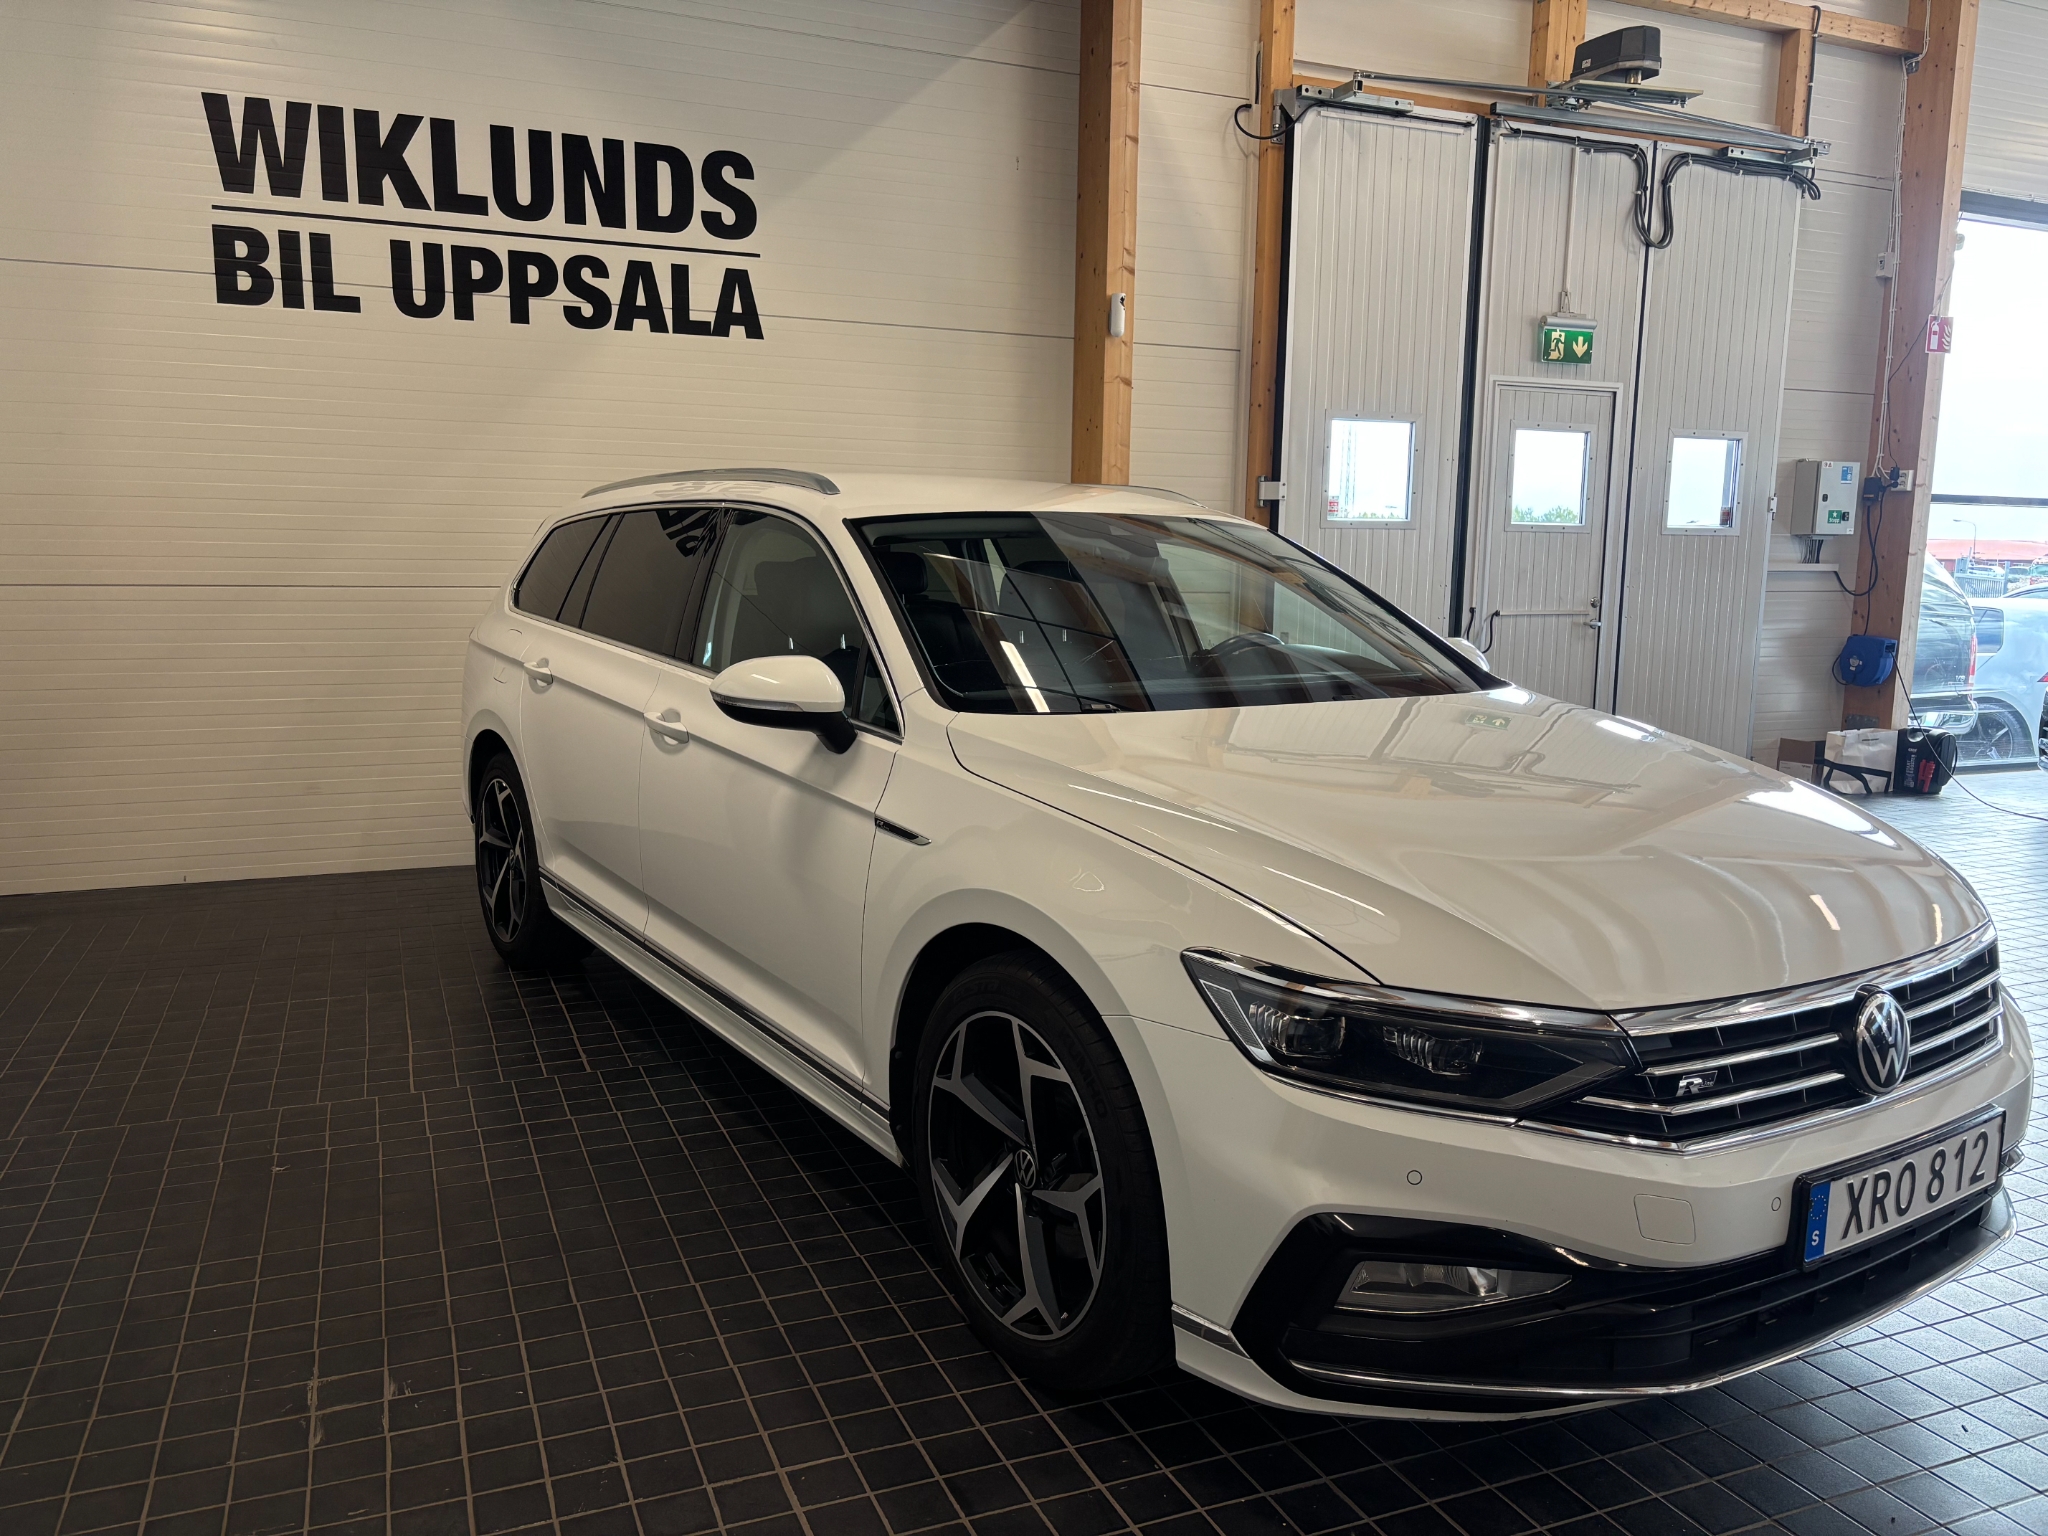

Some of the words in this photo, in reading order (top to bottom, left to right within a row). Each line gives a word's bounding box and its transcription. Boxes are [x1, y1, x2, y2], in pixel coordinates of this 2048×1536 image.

[201, 91, 758, 240] WIKLUNDS
[211, 223, 362, 314] BIL
[389, 238, 765, 340] UPPSALA
[1058, 1027, 1108, 1119] KUMHO
[1811, 1230, 1820, 1246] S
[1841, 1160, 1917, 1240] XRO
[1927, 1129, 1989, 1204] 812
